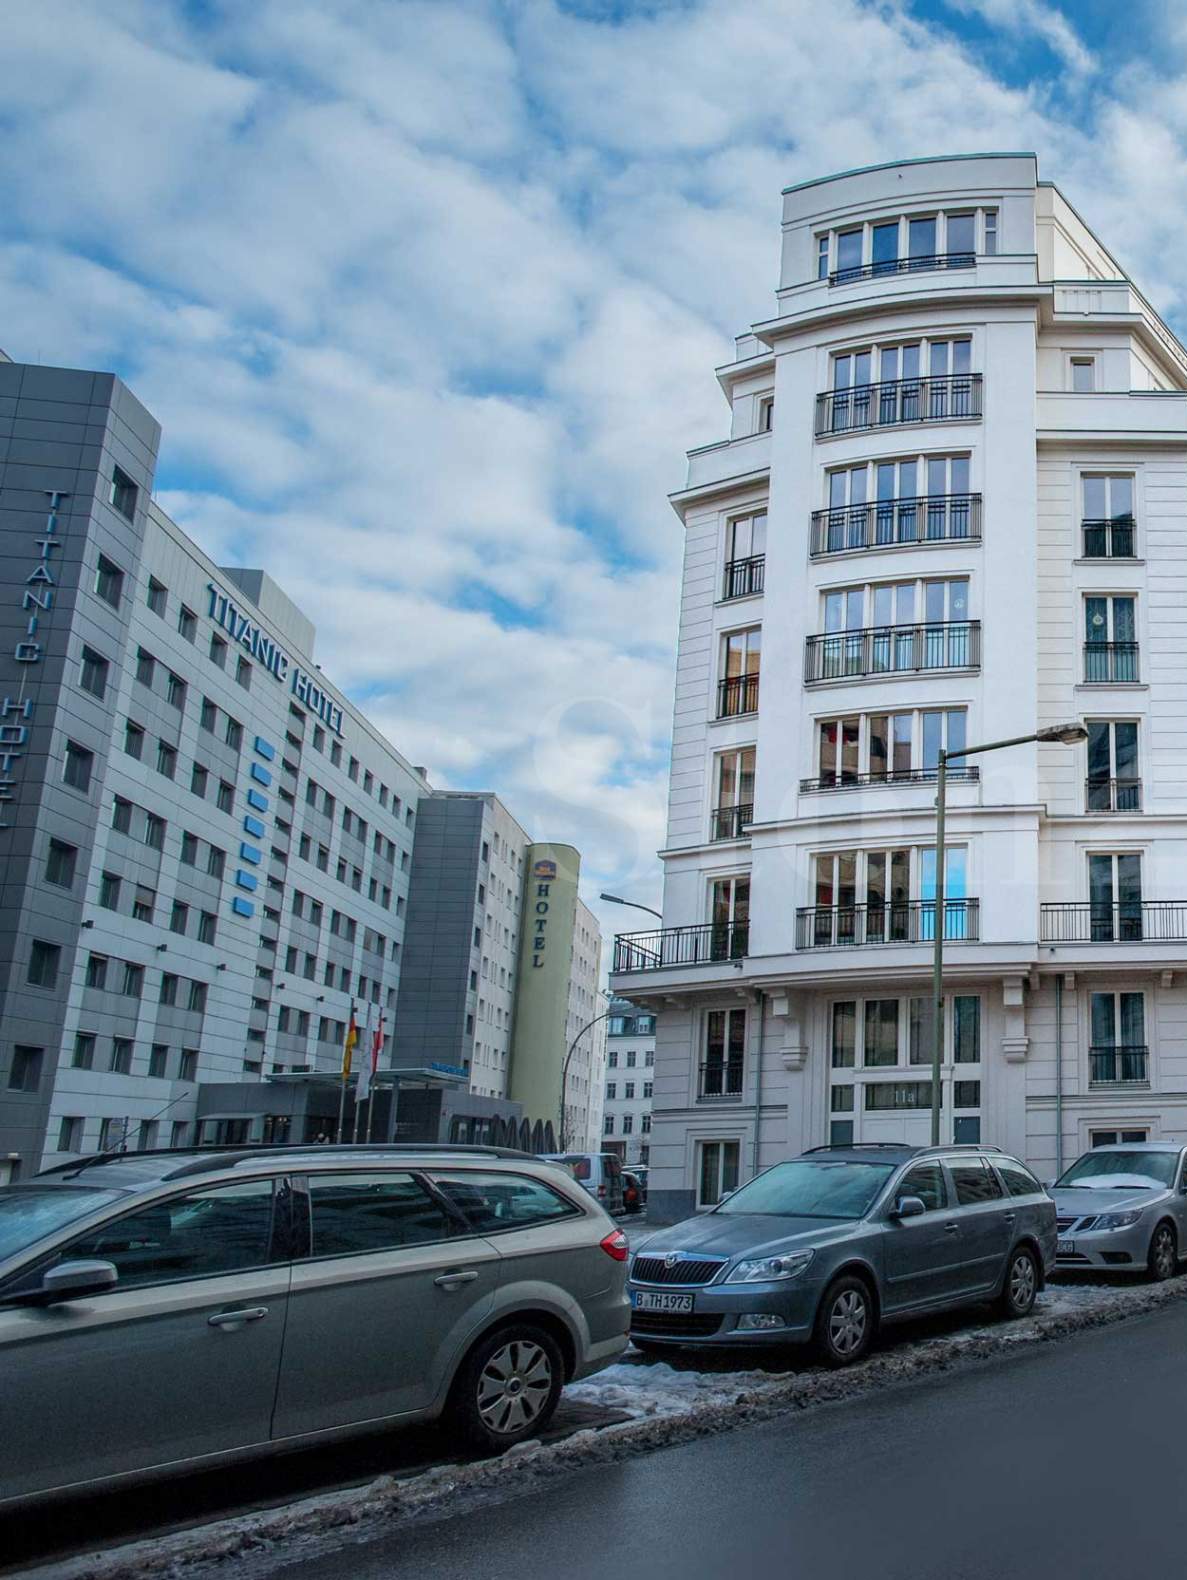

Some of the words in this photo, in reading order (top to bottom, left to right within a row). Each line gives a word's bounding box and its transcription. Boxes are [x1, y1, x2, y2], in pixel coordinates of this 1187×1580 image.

[15, 490, 68, 662] TITANIC
[207, 582, 289, 683] TITANIC
[292, 667, 347, 739] HOTEL
[533, 884, 551, 968] HOTEL
[637, 1293, 644, 1306] B
